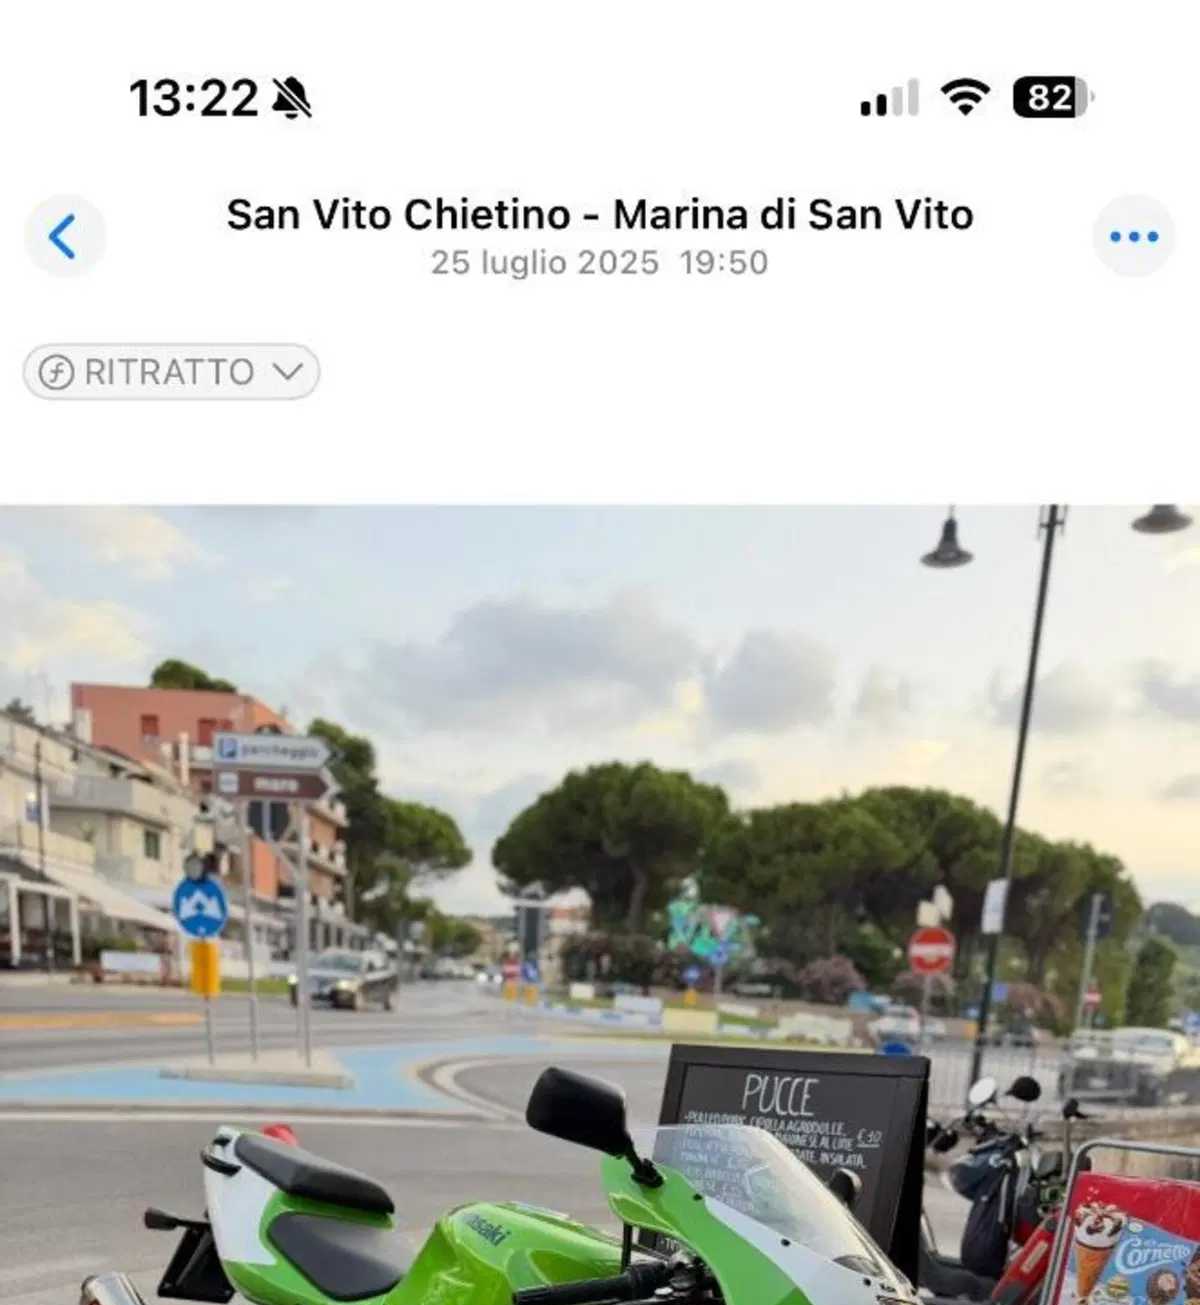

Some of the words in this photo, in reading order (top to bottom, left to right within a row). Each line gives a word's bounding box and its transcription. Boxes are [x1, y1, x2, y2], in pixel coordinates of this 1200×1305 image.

[130, 78, 258, 116] 13:22
[1028, 84, 1071, 112] 82
[228, 199, 299, 230] San
[313, 197, 391, 230] Vito
[405, 197, 570, 230] Chietino
[616, 197, 747, 230] Marina
[761, 197, 795, 230] di
[809, 199, 881, 230] San
[895, 197, 973, 230] Vito
[432, 249, 469, 275] 25
[483, 248, 566, 281] luglio
[579, 249, 658, 275] 2025
[681, 249, 767, 275] 19:50
[86, 358, 254, 386] RITRATTO
[742, 1073, 819, 1117] PUCCE
[1115, 1237, 1191, 1275] Cornetto
